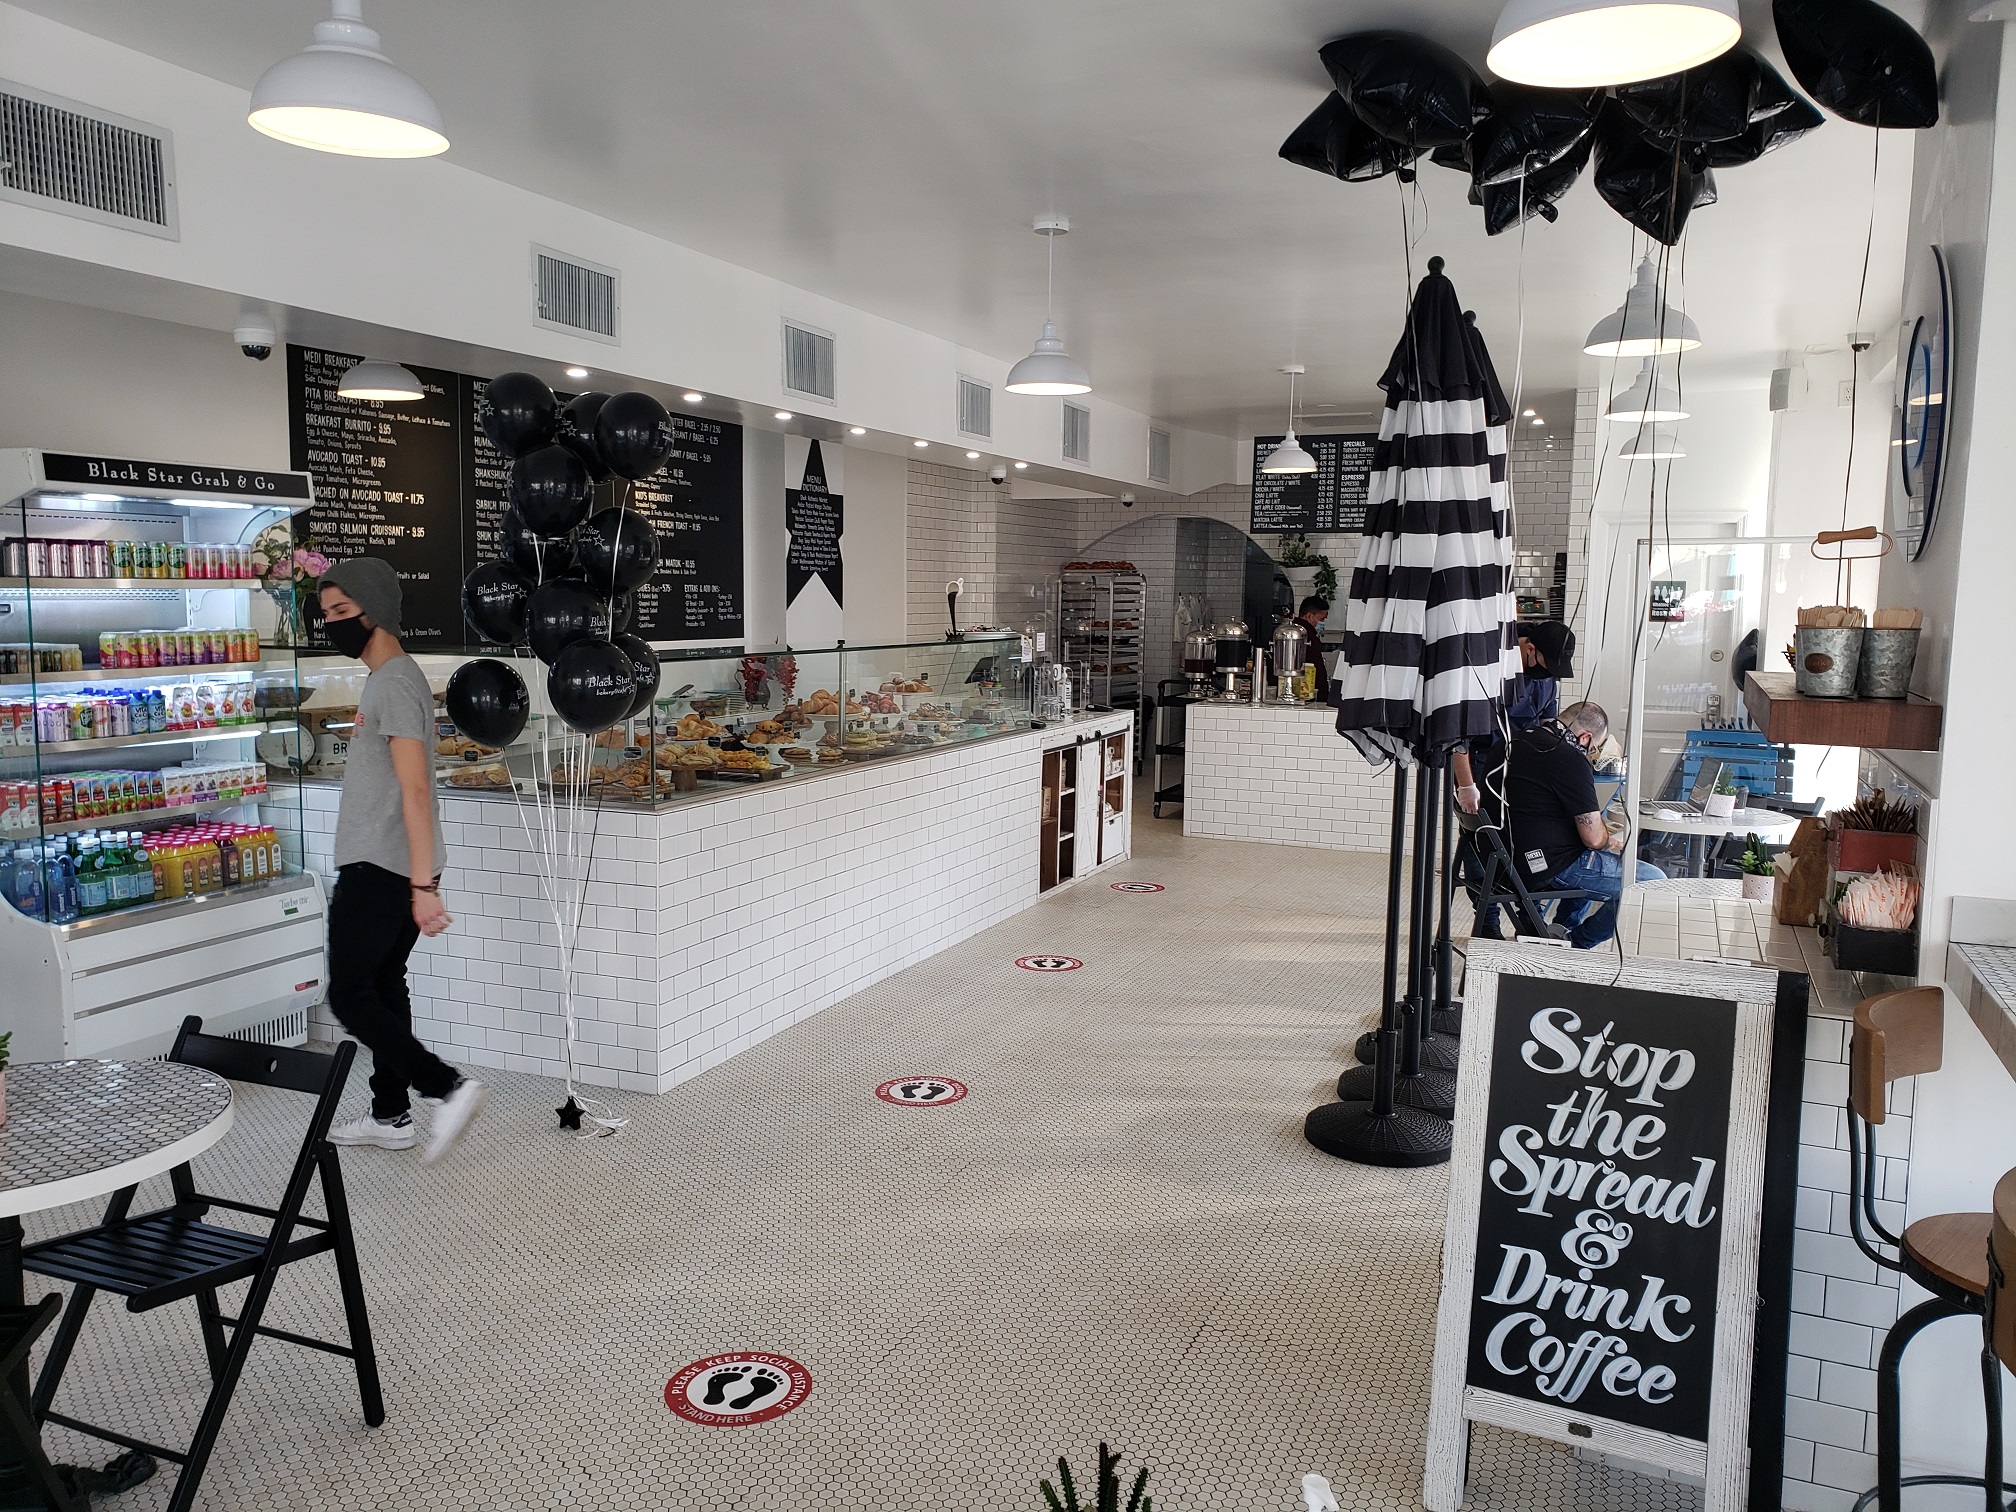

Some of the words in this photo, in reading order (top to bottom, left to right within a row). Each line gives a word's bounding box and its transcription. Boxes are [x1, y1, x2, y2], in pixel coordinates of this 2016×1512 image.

[304, 350, 321, 364] MEDI
[324, 353, 358, 369] BREAKFAST
[310, 365, 321, 376] Eggs
[322, 367, 332, 378] Any
[305, 374, 316, 383] Side
[317, 375, 339, 387] Chopped
[305, 387, 321, 400] PITA
[430, 384, 445, 396] Olives,
[311, 401, 323, 412] Eggs
[325, 403, 350, 413] Scrambled
[306, 413, 342, 429] BREAKFAST
[345, 418, 372, 432] BURRITO
[685, 420, 698, 430] BAGEL
[307, 427, 316, 437] Egg
[322, 429, 340, 439] Cheese,
[357, 433, 377, 444] Sriracha,
[378, 436, 398, 446] Avocado,
[693, 433, 706, 443] BAGEL
[307, 436, 326, 447] Tomato,
[345, 441, 362, 451] Sprouts
[308, 449, 339, 464] AVOCADO
[342, 453, 364, 466] TOAST
[475, 457, 489, 465] Includes
[87, 462, 140, 481] Black
[148, 467, 184, 484] Star
[192, 472, 230, 488] Grab
[237, 475, 248, 489] &
[254, 477, 276, 491] Go
[308, 463, 328, 473] Avocado
[330, 465, 344, 475] Mash,
[346, 467, 356, 476] Feta
[358, 468, 376, 478] Cheese,
[326, 474, 349, 485] Tomatoes,
[353, 477, 382, 488] Microgreens
[807, 475, 822, 484] MENU
[313, 486, 337, 499] OACHED
[340, 488, 349, 500] ON
[352, 489, 382, 502] AVOCADO
[384, 491, 404, 504] TOAST
[803, 484, 828, 494] DICTIONARY
[648, 492, 674, 504] BREAKFAST
[331, 501, 346, 511] Mash,
[348, 502, 368, 511] Poached
[476, 500, 497, 511] SABICH
[310, 509, 326, 519] Aleppo
[340, 511, 358, 521] Flakes,
[359, 512, 386, 522] Microgreens
[310, 521, 338, 534] SMOKED
[340, 523, 368, 535] SALMON
[371, 525, 405, 537] CROISSANT
[657, 520, 675, 530] FRENCH
[676, 522, 688, 531] TOAST
[388, 538, 396, 546] Dill
[323, 545, 343, 554] Poached
[344, 546, 353, 556] Egg
[418, 572, 430, 580] Salad
[477, 583, 499, 596] Black
[502, 582, 519, 591] Star
[590, 616, 607, 627] Black
[415, 628, 428, 636] Green
[428, 628, 442, 636] Olives
[635, 662, 651, 673] Star
[588, 675, 613, 688] Black
[616, 675, 631, 686] Star
[1521, 1007, 1696, 1107] Stop
[1547, 1086, 1667, 1161] the
[1489, 1125, 1717, 1229] Spread
[1561, 1208, 1634, 1269] &
[1481, 1244, 1696, 1343] Drink
[1485, 1312, 1676, 1404] Coffee
[672, 1366, 703, 1395] PLEASE
[706, 1355, 742, 1367] KEEP
[750, 1354, 795, 1372] SOCIAL
[776, 1372, 806, 1411] DISTANCE
[679, 1403, 715, 1423] STAND
[716, 1415, 753, 1424] HERE
